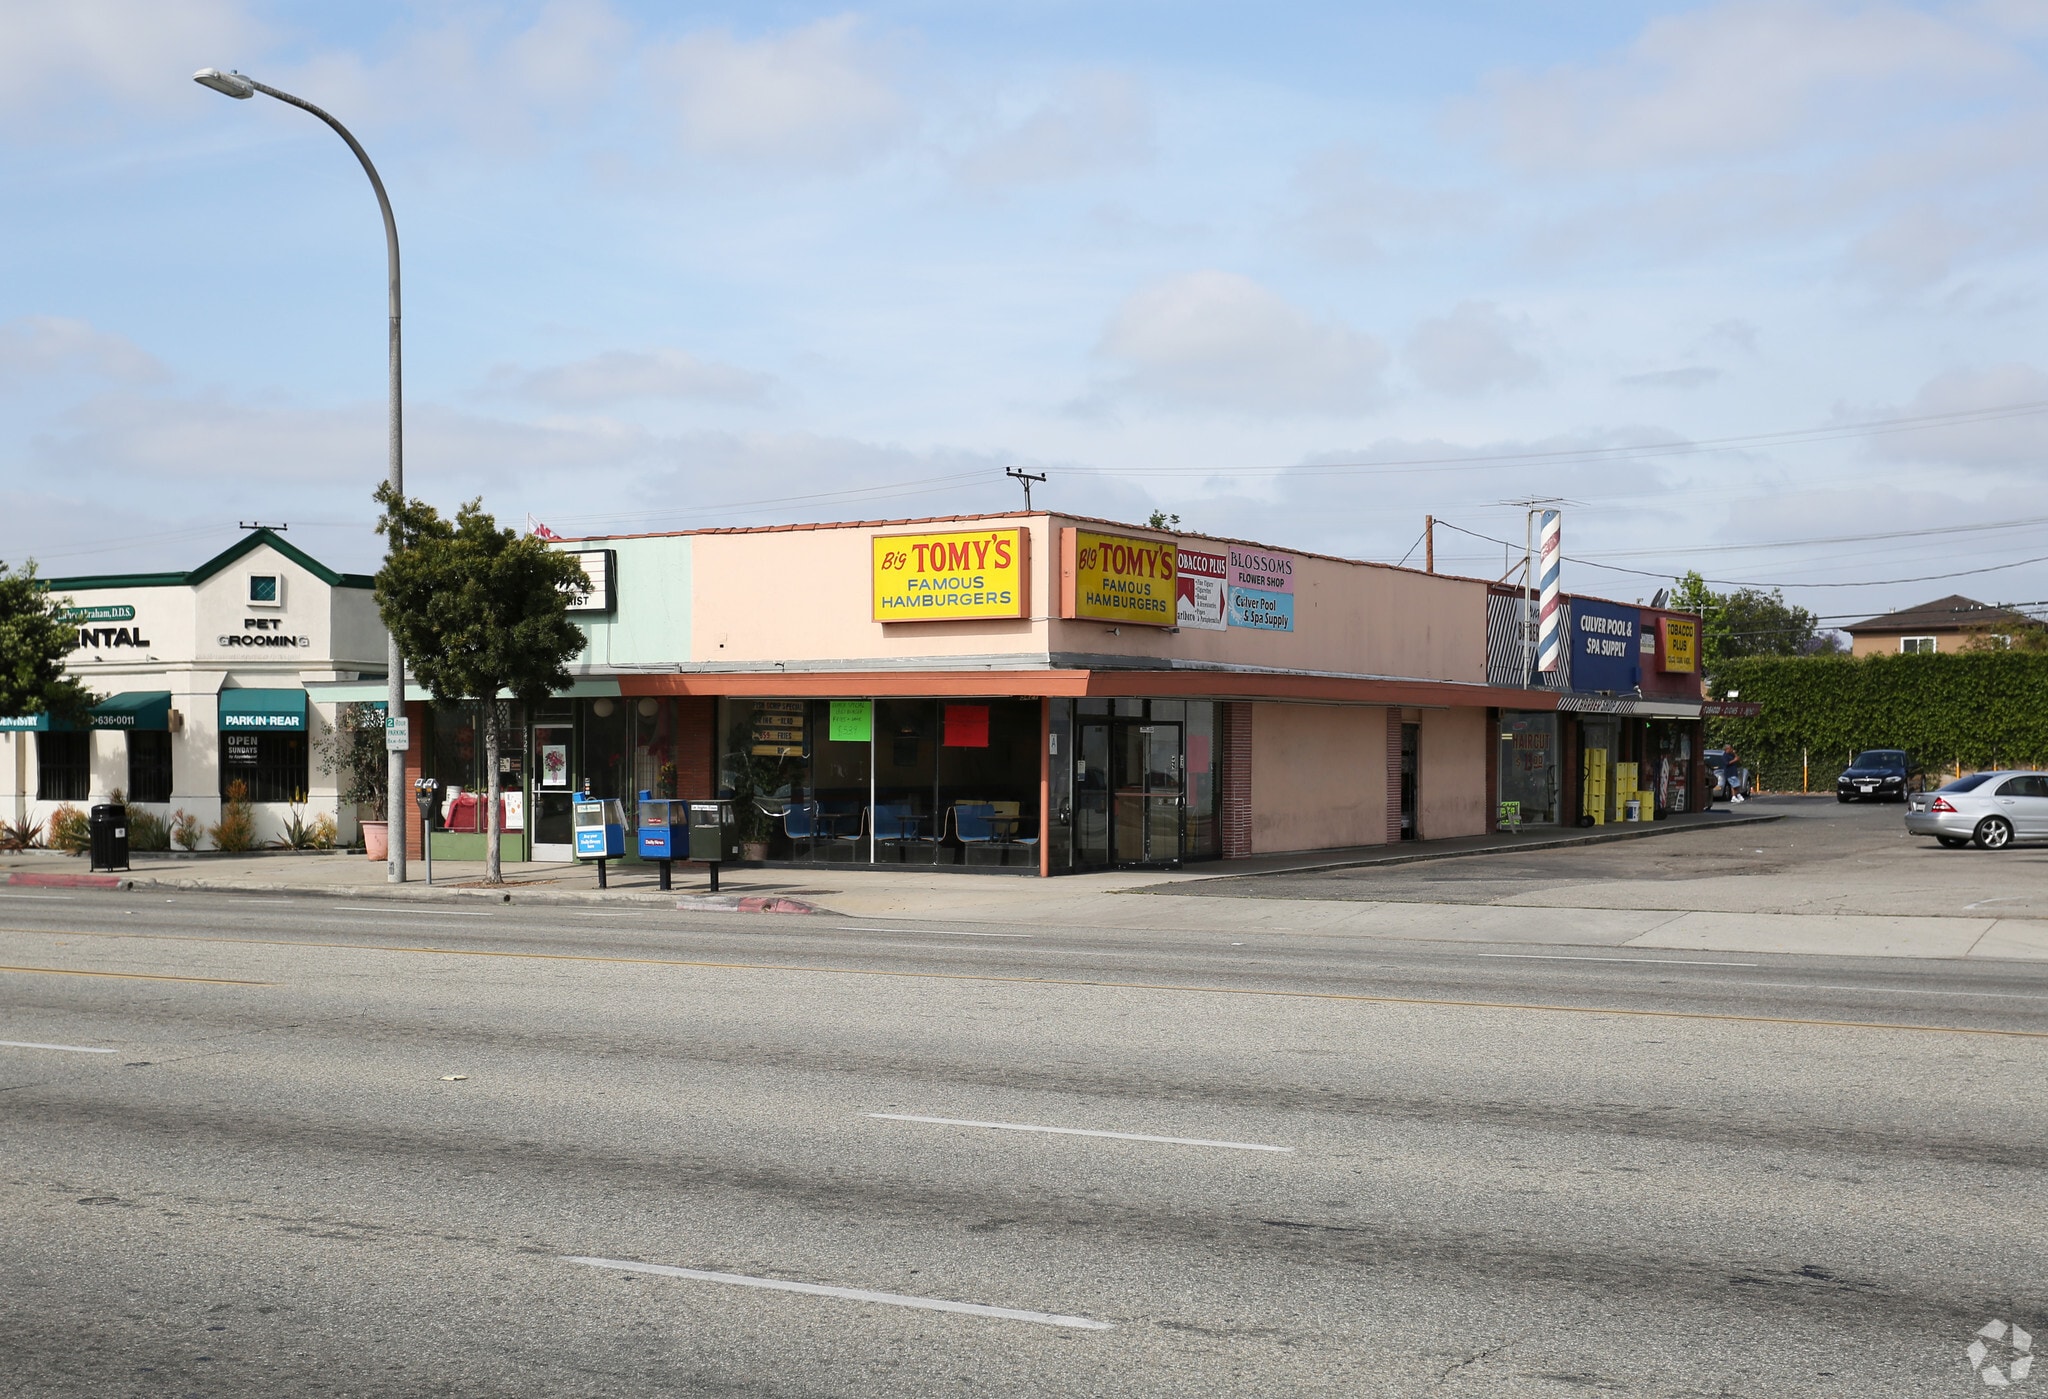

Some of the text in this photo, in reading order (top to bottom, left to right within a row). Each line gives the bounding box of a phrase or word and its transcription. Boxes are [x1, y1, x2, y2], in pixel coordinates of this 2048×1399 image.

[881, 533, 1011, 572] Big TOMY'S
[1099, 542, 1173, 580] TOMY'S
[1178, 553, 1226, 575] OBACCO PLUS
[1230, 552, 1292, 575] BLOSSOMS
[908, 576, 984, 591] FAMOUS
[1103, 578, 1151, 596] FAMOUS
[1238, 573, 1285, 588] FLOWER SHOP
[882, 591, 1011, 609] HAMBURGERS
[1087, 592, 1166, 612] HAMBURGERS
[1235, 595, 1276, 611] Culver Pool
[112, 607, 132, 617] D.D.S.
[1178, 610, 1196, 621] arlboro
[1244, 610, 1289, 629] & Spa Supply
[244, 618, 281, 629] PET
[1580, 615, 1632, 637] CULVER POOL &
[1667, 623, 1693, 637] TOBACCO
[66, 627, 150, 648] ENTAL
[1672, 640, 1687, 651] PLUS
[1586, 637, 1600, 654] SPA
[1601, 639, 1627, 657] SUPPLY
[226, 715, 300, 726] PARK IN REAR
[387, 718, 394, 728] 2
[228, 736, 258, 746] OPEN
[1512, 733, 1550, 750] HAIRCUT
[228, 746, 258, 754] SUNDAYS
